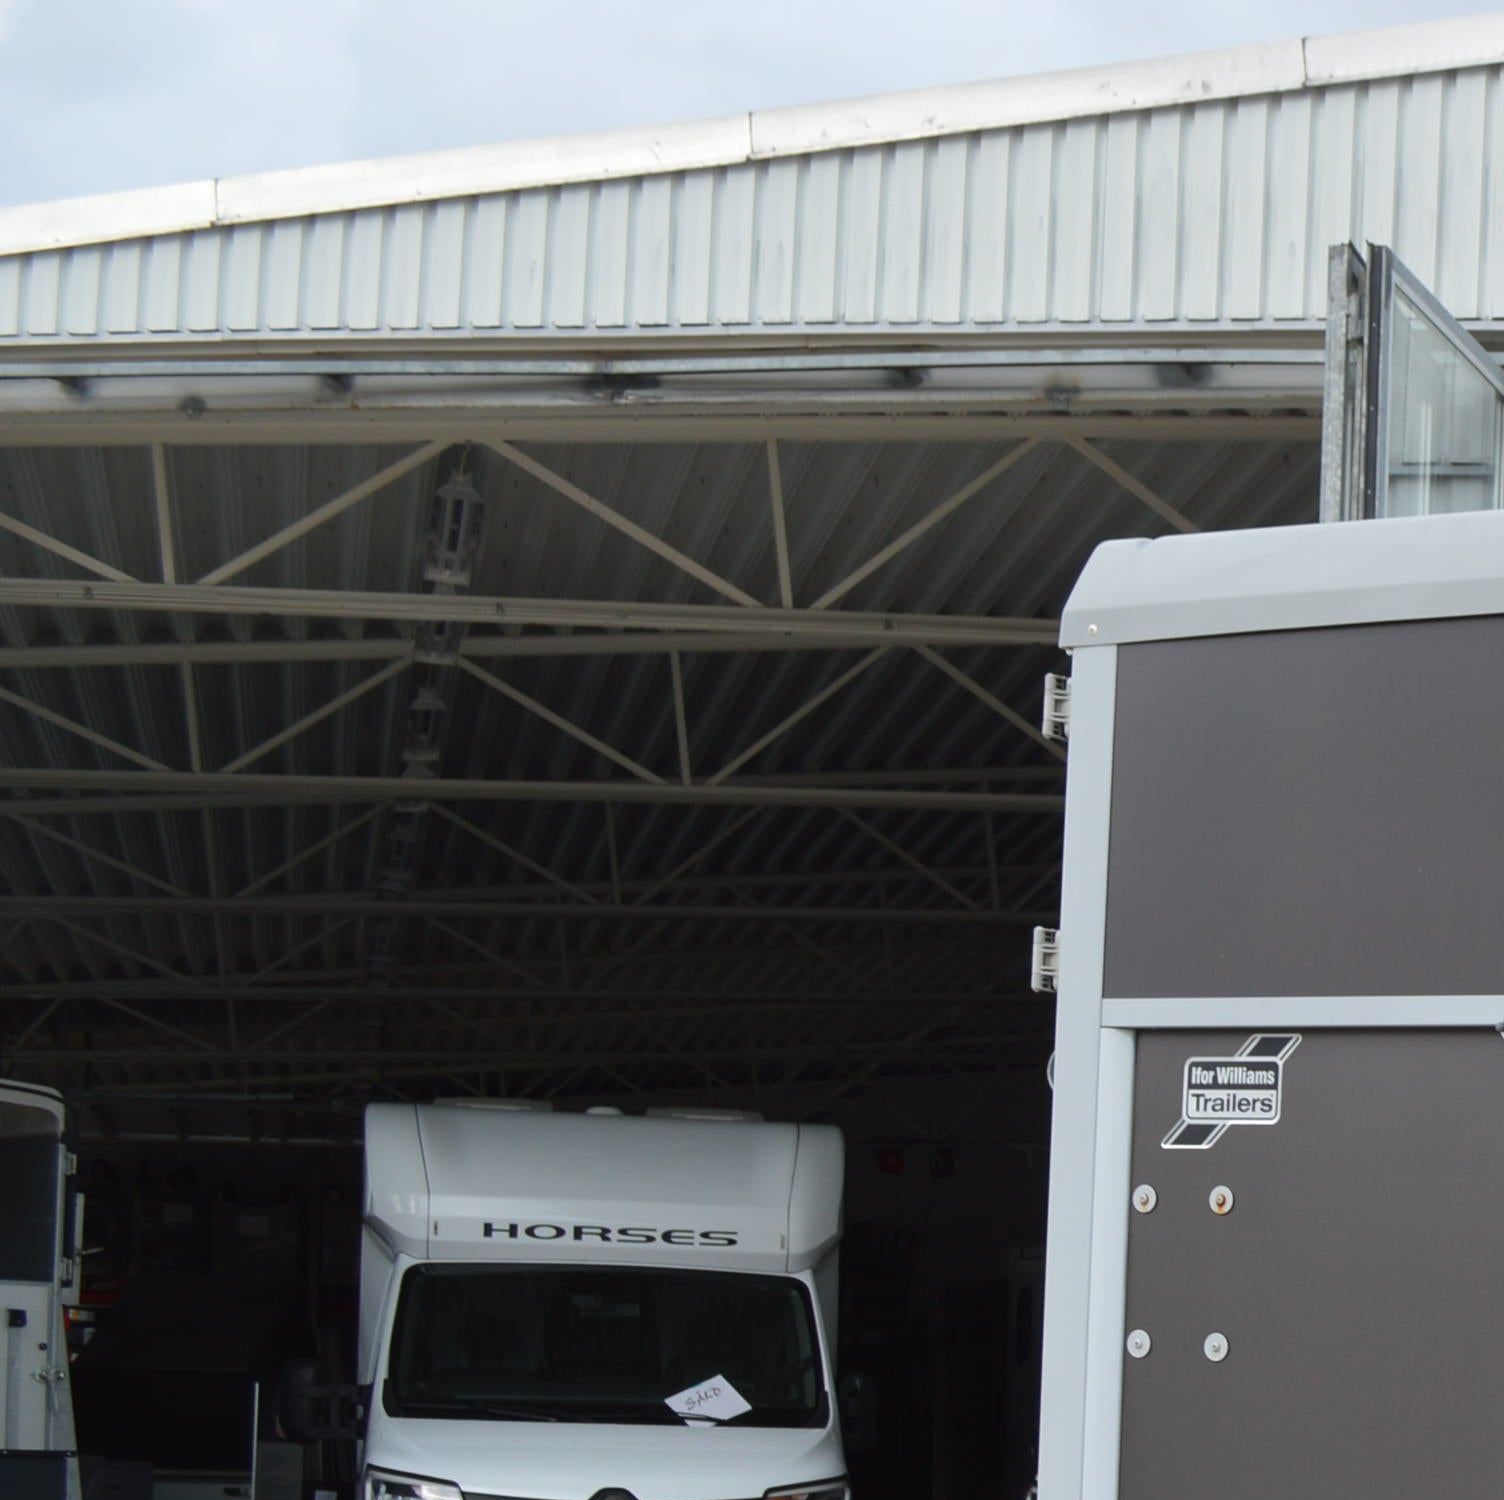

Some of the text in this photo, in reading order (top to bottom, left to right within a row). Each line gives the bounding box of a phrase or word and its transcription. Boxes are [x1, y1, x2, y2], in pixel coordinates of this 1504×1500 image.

[1191, 1066, 1276, 1086] Ifor Williams
[1191, 1093, 1273, 1113] Trailers
[482, 1222, 739, 1247] HORSES
